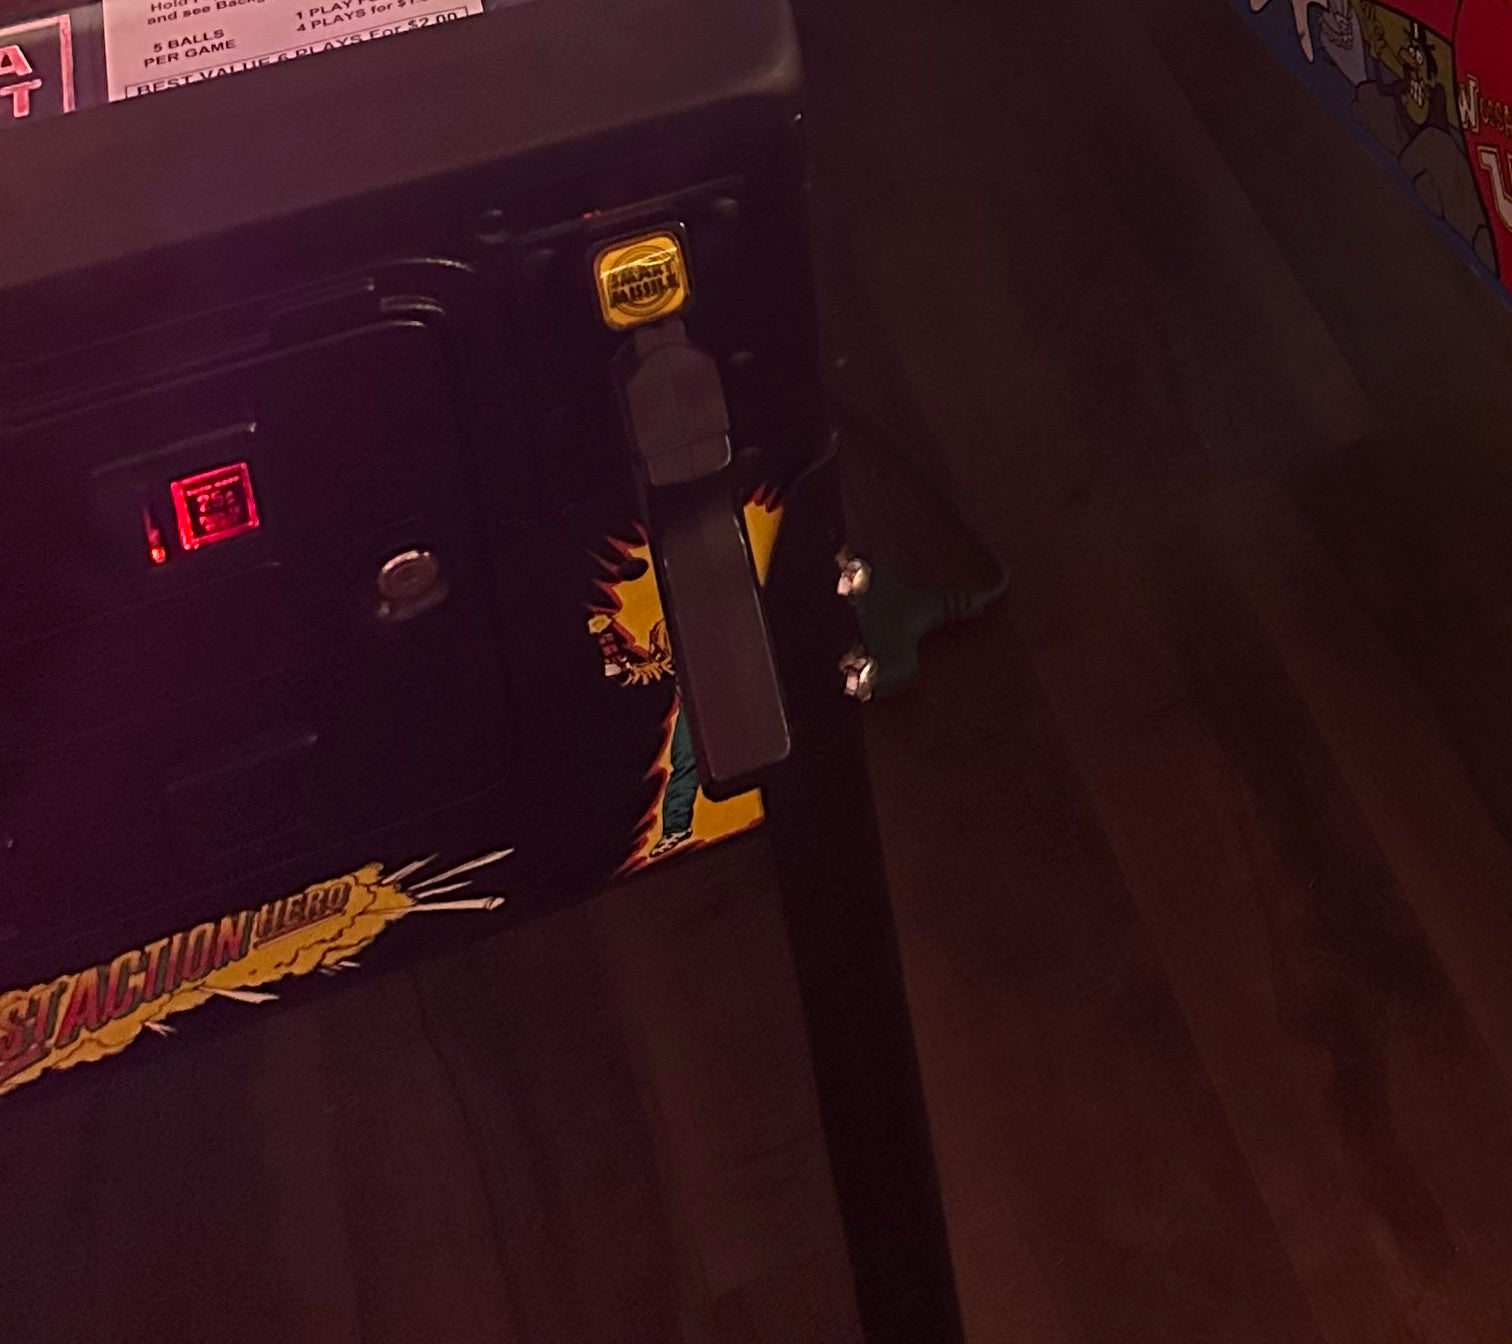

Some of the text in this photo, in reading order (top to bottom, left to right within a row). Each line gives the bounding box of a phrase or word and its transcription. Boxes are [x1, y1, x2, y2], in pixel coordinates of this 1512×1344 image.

[147, 10, 177, 26] and
[182, 4, 211, 19] see
[296, 23, 306, 33] 4
[311, 9, 366, 30] PLAYS
[370, 2, 393, 16] for
[297, 11, 304, 20] 1
[309, 0, 353, 19] PLAY
[136, 76, 193, 96] BEST
[200, 56, 272, 82] VALUE
[294, 33, 364, 59] PLAYS
[369, 24, 402, 41] For
[407, 12, 459, 31] $2.00
[144, 39, 236, 68] PER GAME
[153, 29, 225, 53] 5 BALLS
[58, 915, 251, 1043] ACTION
[255, 883, 351, 947] HERO
